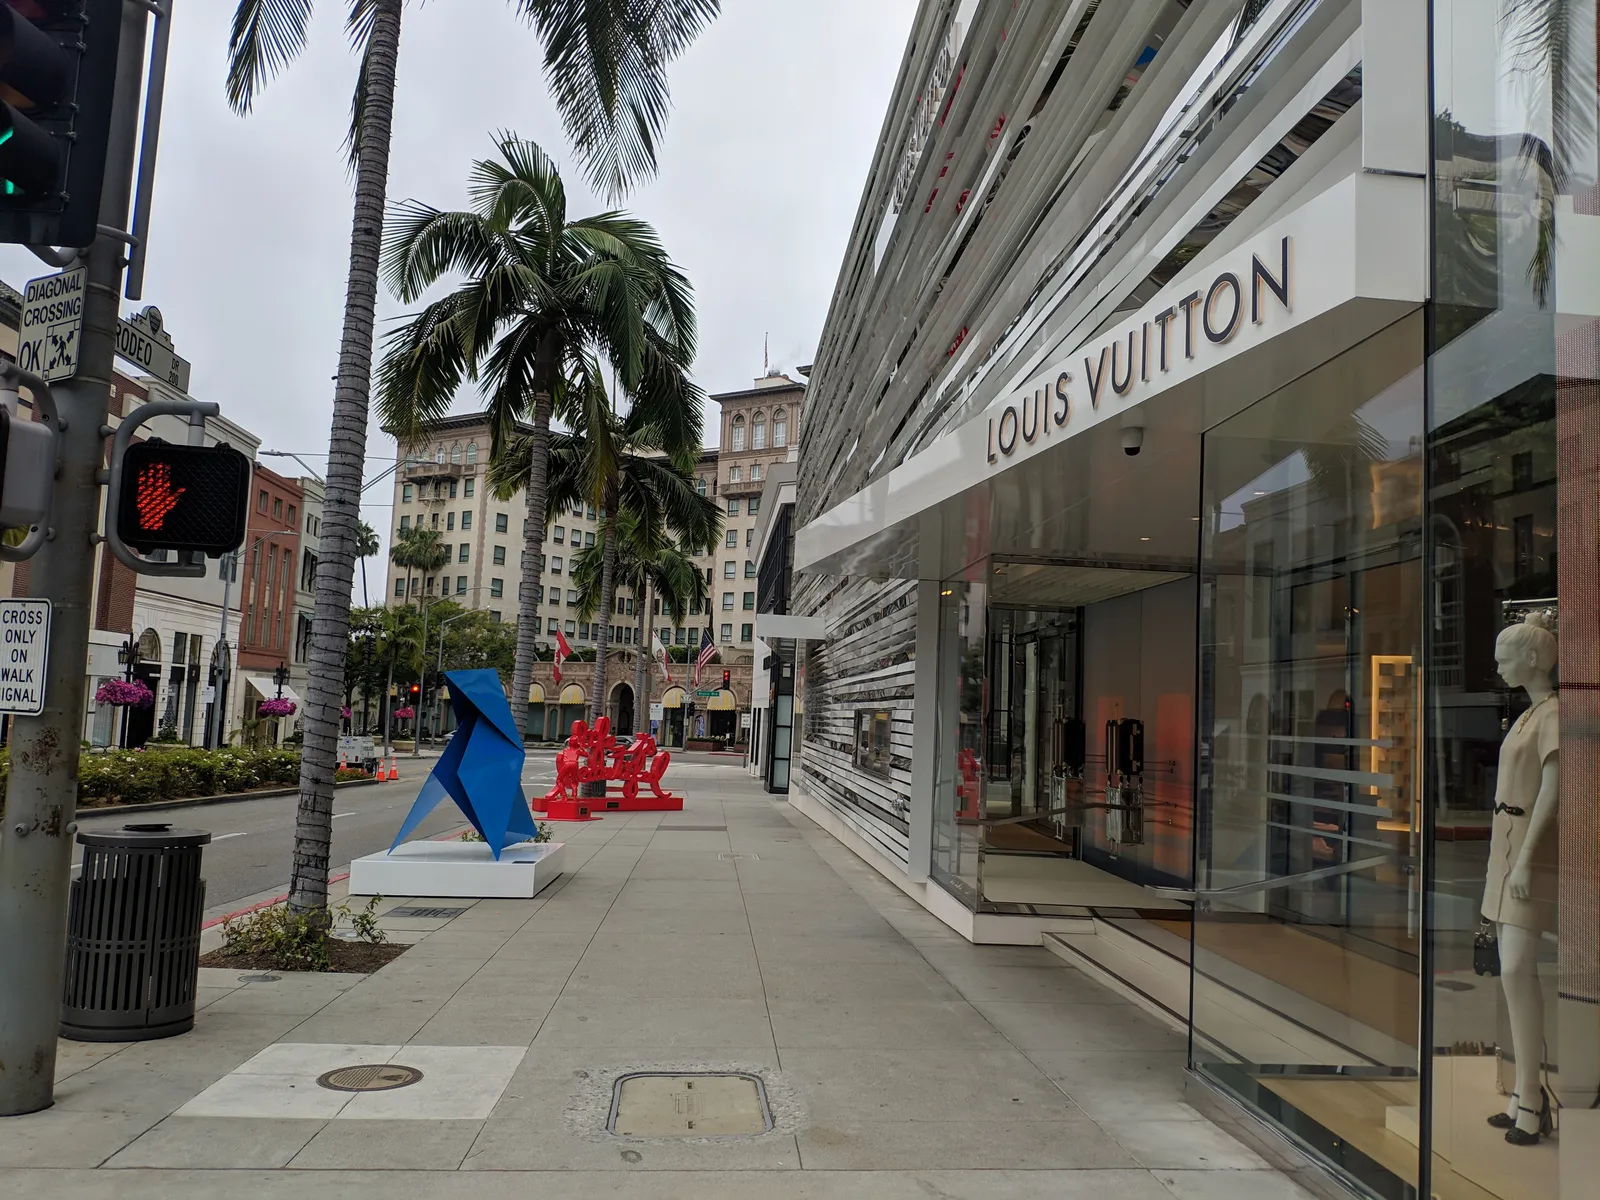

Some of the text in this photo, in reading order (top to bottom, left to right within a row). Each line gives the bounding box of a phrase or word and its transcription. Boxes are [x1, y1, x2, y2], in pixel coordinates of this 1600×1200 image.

[27, 273, 82, 303] DIAGONAL
[24, 297, 81, 327] CROSSING
[116, 323, 152, 366] RODEO
[987, 235, 1294, 464] LOUIS VUITTON
[19, 339, 42, 371] OK
[171, 358, 180, 372] DR
[168, 371, 179, 386] 200
[2, 610, 43, 624] CROSS
[5, 629, 37, 643] ONLY
[11, 649, 28, 663] ON
[1, 668, 34, 683] WALK
[0, 687, 37, 702] IGNAL
